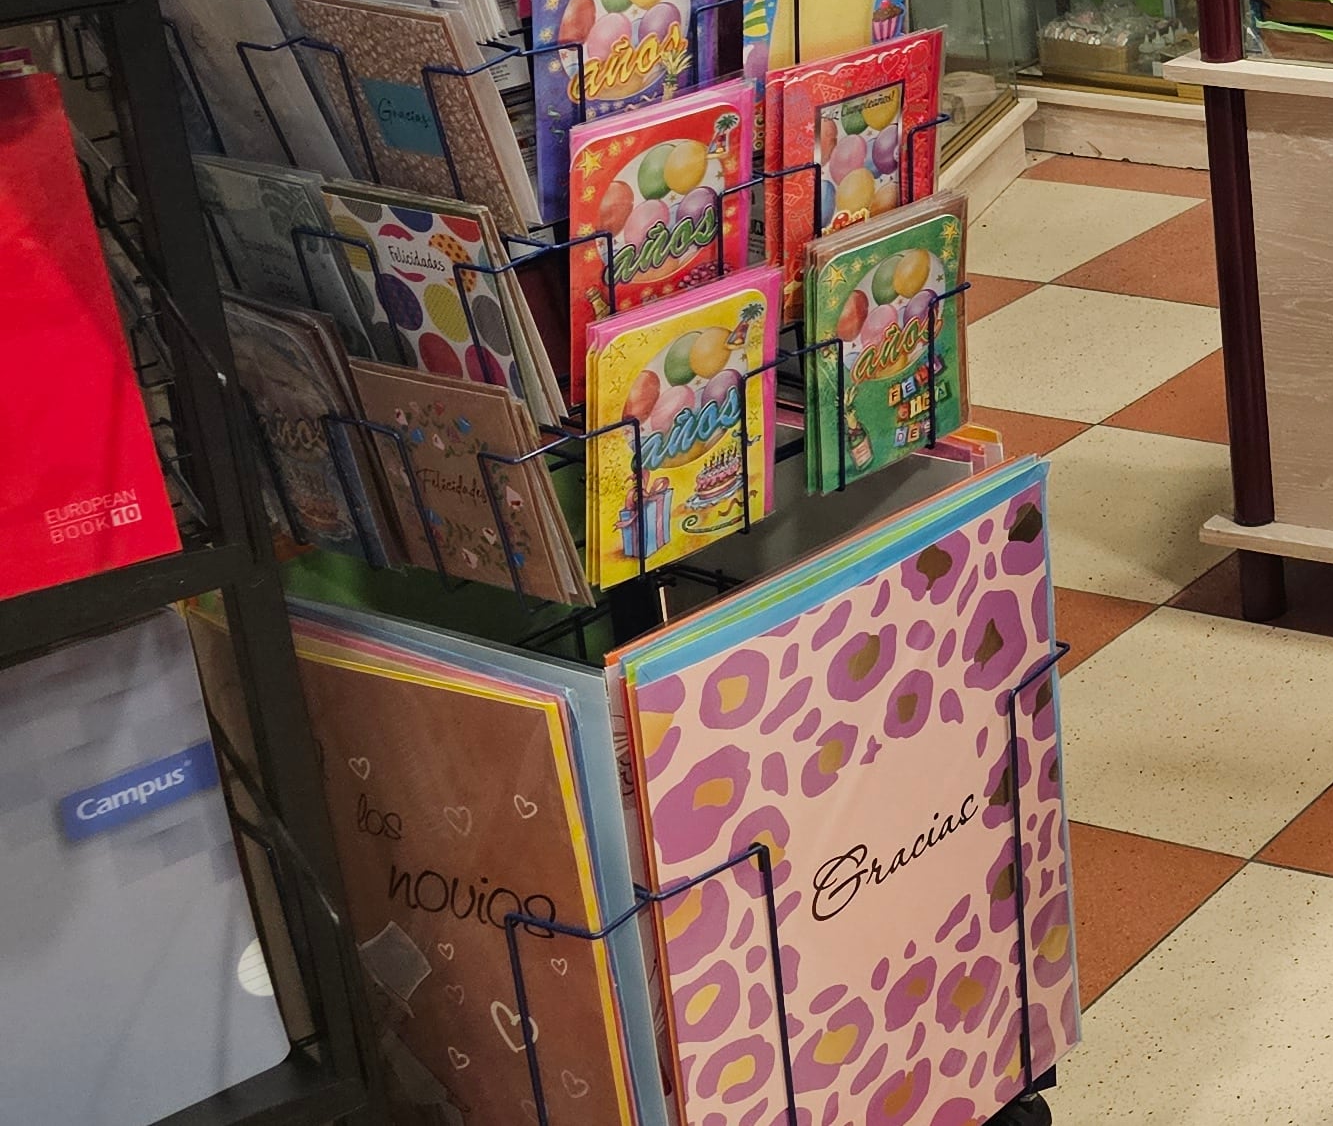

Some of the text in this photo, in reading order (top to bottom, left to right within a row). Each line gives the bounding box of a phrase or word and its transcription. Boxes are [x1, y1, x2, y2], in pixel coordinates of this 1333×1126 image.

[388, 243, 447, 274] Felicidades
[603, 203, 718, 284] años
[632, 384, 742, 472] años
[44, 487, 138, 526] EUROPEAN
[49, 507, 142, 545] BOOK 10
[355, 793, 403, 841] los
[810, 792, 980, 922] Gracias
[388, 864, 557, 939] novios
